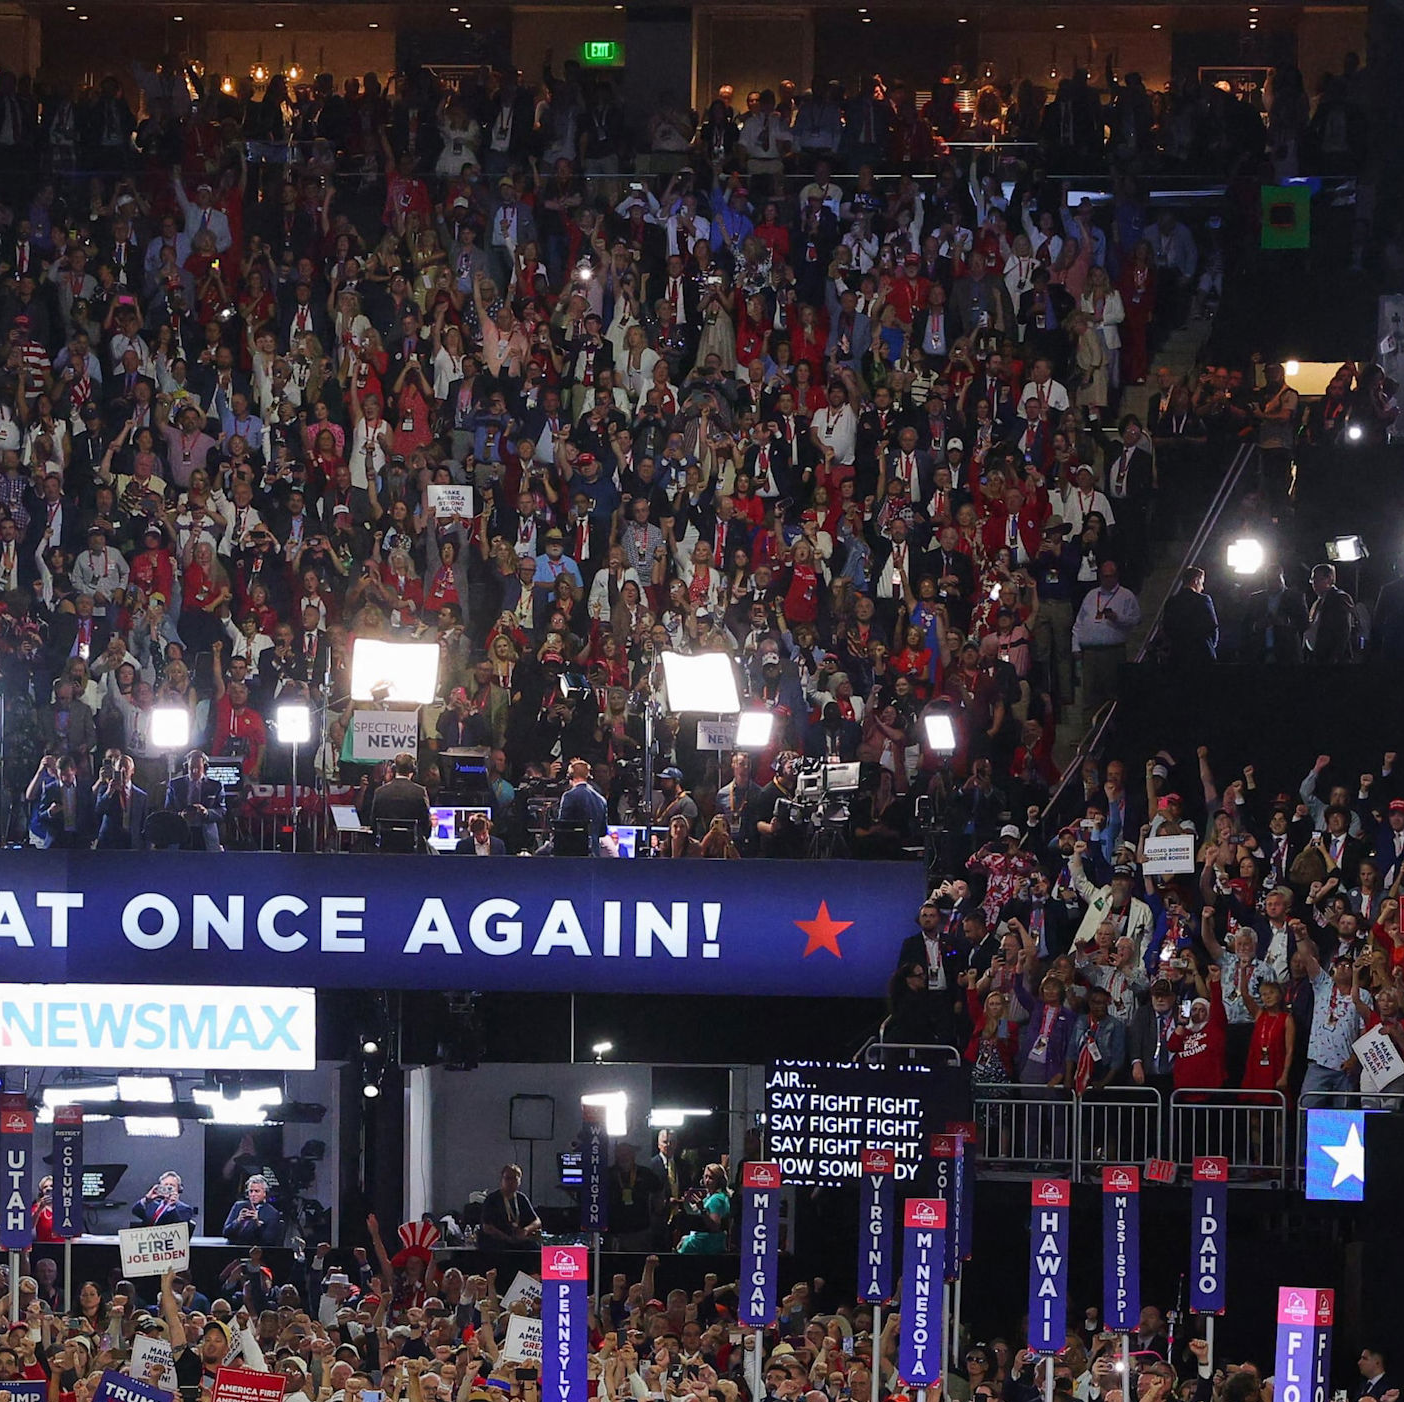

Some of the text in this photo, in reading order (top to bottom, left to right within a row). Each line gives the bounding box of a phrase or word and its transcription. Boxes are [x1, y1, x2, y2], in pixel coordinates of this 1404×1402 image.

[591, 42, 610, 57] EXIT
[354, 722, 416, 734] SPECTRUM
[368, 735, 416, 748] NEWS
[122, 892, 366, 953] ONCE
[403, 897, 721, 958] AGAIN!
[1, 1000, 301, 1052] NEWSMAX
[1178, 1043, 1207, 1058] TRUMP
[1368, 1047, 1384, 1071] GREAT
[1371, 1040, 1390, 1072] AMERICA
[1379, 1041, 1394, 1062] MAKE
[1363, 1051, 1380, 1076] AGAIN!
[771, 1071, 817, 1088] AIR...
[771, 1092, 924, 1118] SAY FIGHT FIGHT,
[770, 1114, 923, 1140] SAY FIGHT FIGHT,
[770, 1136, 862, 1156] SAY FIGHT
[589, 1125, 601, 1224] WASHINGTON
[1148, 1159, 1174, 1182] EXIT
[6, 1150, 26, 1230] UTAH
[62, 1145, 73, 1228] COLUMBIA
[130, 1229, 182, 1241] HI MOM
[138, 1239, 175, 1254] FIRE
[867, 1175, 885, 1296] VIRGINIA
[1198, 1196, 1219, 1295] IDAHO
[126, 1249, 185, 1265] JOE BIDEN
[750, 1193, 770, 1317] MICHIGAN
[1115, 1196, 1127, 1323] MISSISSIPPI
[1035, 1211, 1062, 1342] HAWAII
[911, 1232, 933, 1376] MINNESOTA
[218, 1383, 281, 1398] AMERICA FIRST
